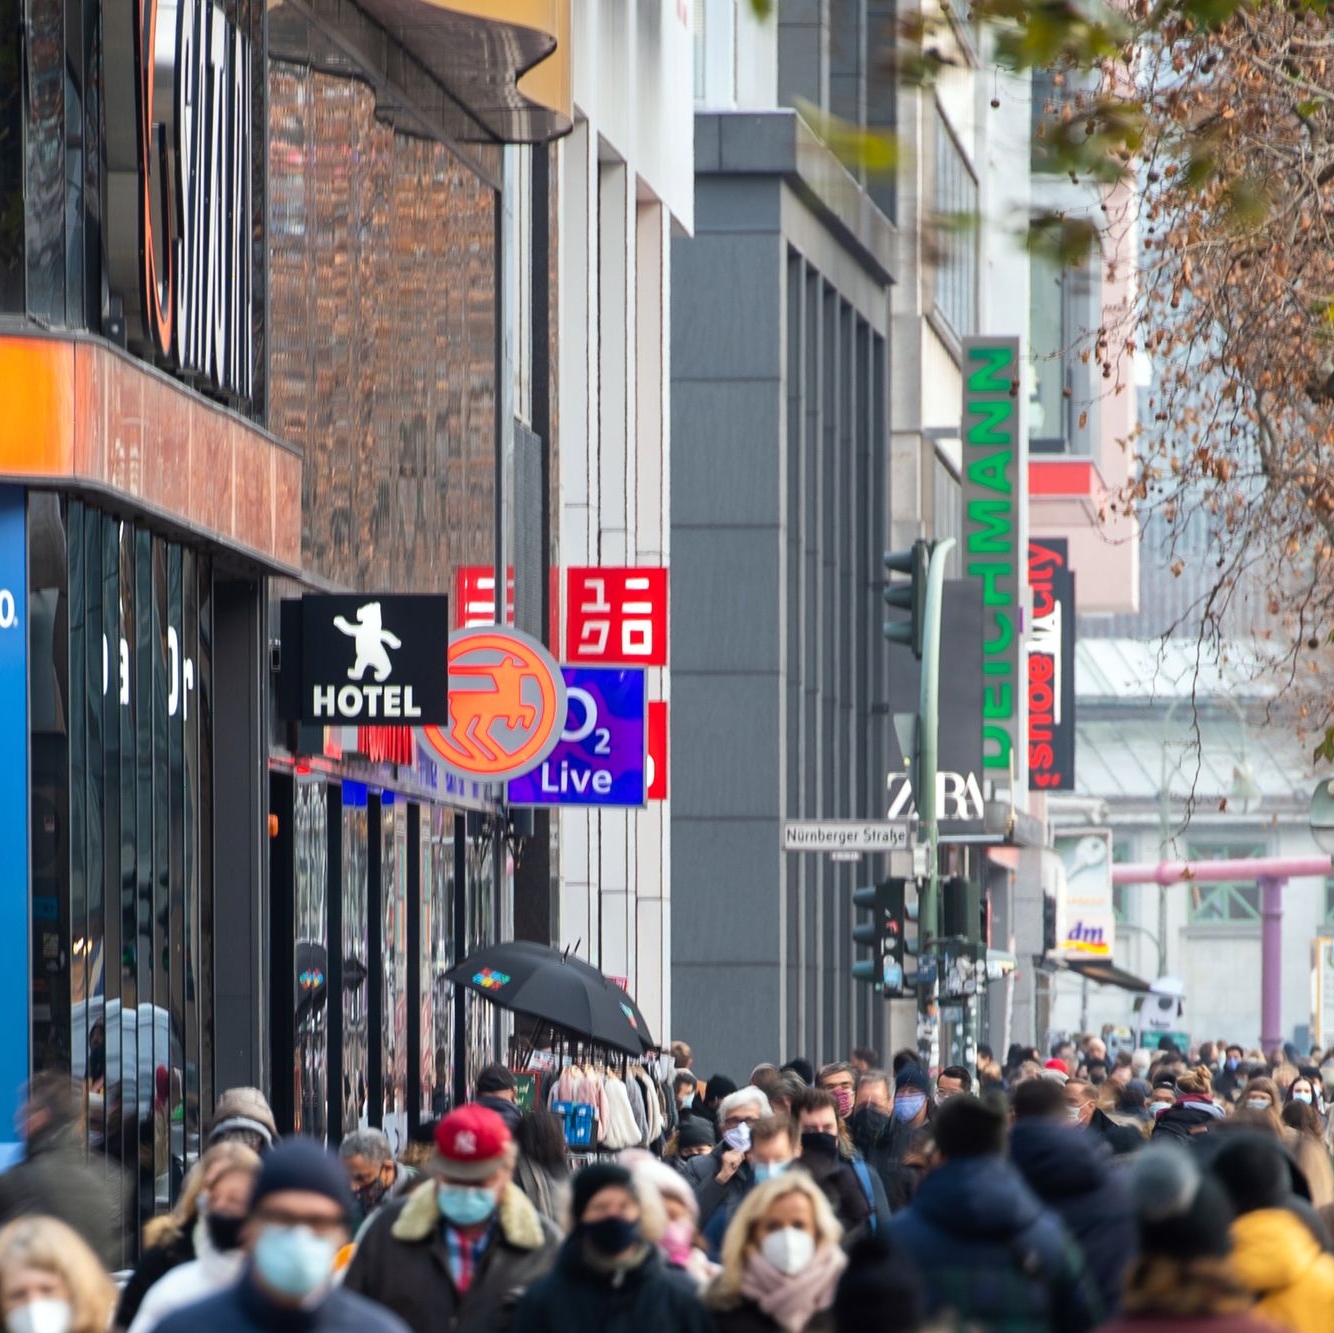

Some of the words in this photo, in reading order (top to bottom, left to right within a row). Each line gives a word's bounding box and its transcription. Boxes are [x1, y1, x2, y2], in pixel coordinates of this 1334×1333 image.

[968, 346, 1013, 768] DEICHMANN
[313, 684, 422, 718] HOTEL
[540, 761, 613, 794] Live
[887, 771, 984, 820] ZRA
[787, 826, 858, 846] Nürnberger
[864, 826, 905, 847] Straße
[1068, 921, 1104, 942] dm
